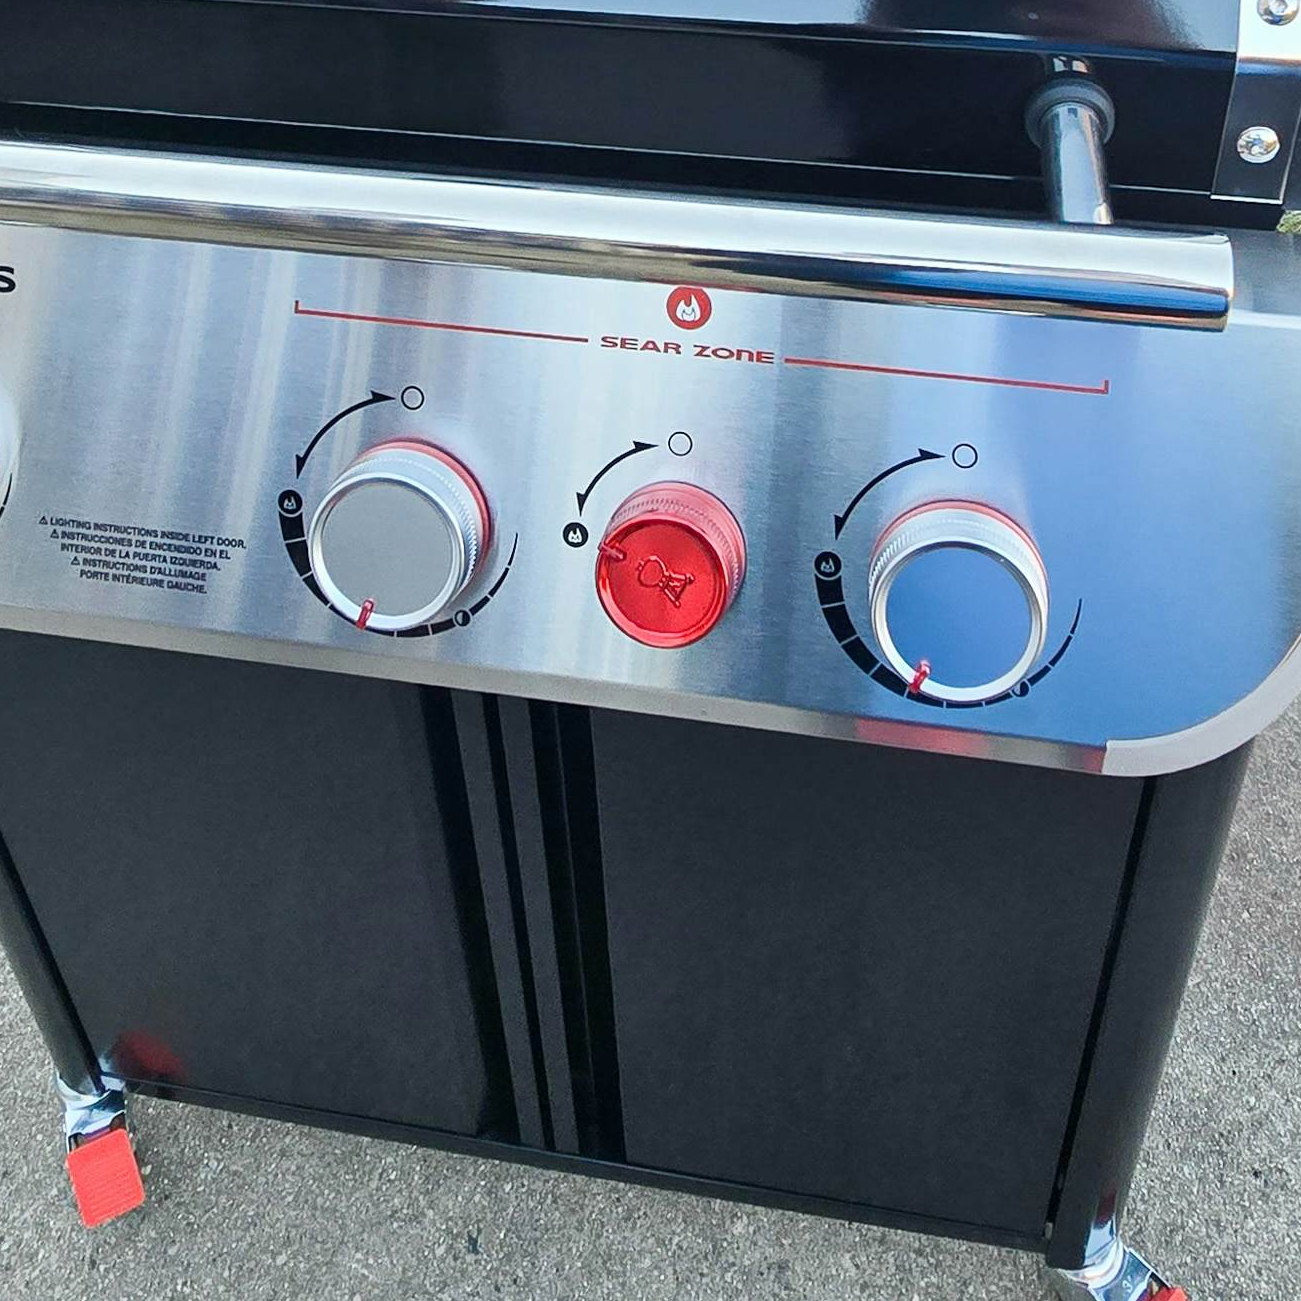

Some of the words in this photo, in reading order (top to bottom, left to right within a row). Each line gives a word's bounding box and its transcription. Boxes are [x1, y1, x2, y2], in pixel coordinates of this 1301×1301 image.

[600, 336, 682, 354] SEAR
[693, 344, 775, 364] ZONE
[50, 517, 91, 530] LIGHTING
[93, 522, 158, 538] INSTRUCTIONS
[160, 530, 190, 543] INSIDE
[192, 534, 215, 545] LEFT
[217, 537, 246, 549] DOOR.
[61, 531, 133, 547] INSTRUCCIONES
[135, 539, 147, 549] DE
[149, 541, 202, 556] ENCENDIDO
[204, 548, 217, 558] EN
[218, 549, 231, 560] EL
[60, 543, 102, 556] INTERIOR
[104, 548, 116, 558] DE
[119, 549, 130, 559] LA
[133, 551, 168, 564] PUERTA
[169, 556, 220, 571] IZQUIERDA.
[82, 558, 147, 574] INSTRUCTIONS
[80, 569, 110, 581] PORTE
